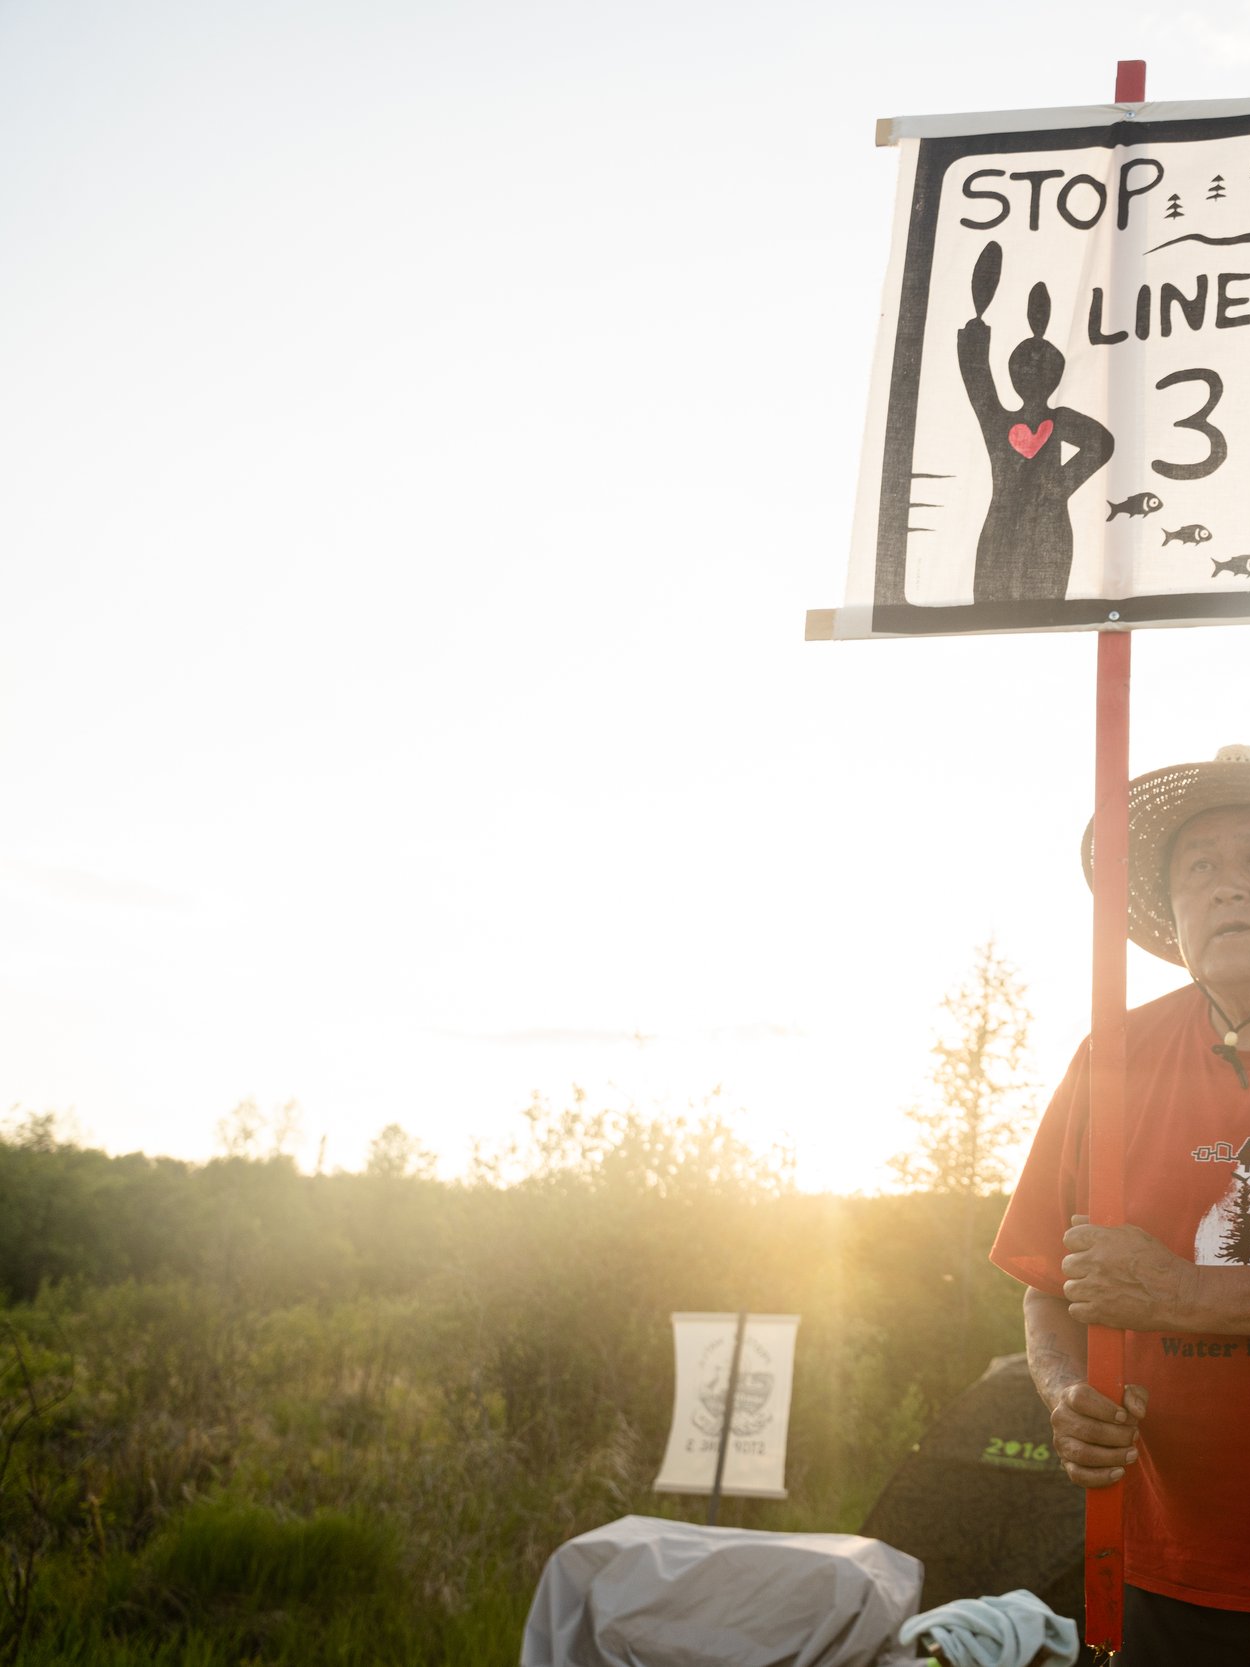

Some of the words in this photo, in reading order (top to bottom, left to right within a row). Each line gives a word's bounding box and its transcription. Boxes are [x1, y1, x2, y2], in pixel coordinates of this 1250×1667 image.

[960, 158, 1164, 231] STOP
[1151, 367, 1228, 480] 3
[1161, 1337, 1238, 1358] Water
[985, 1437, 1051, 1461] 2016
